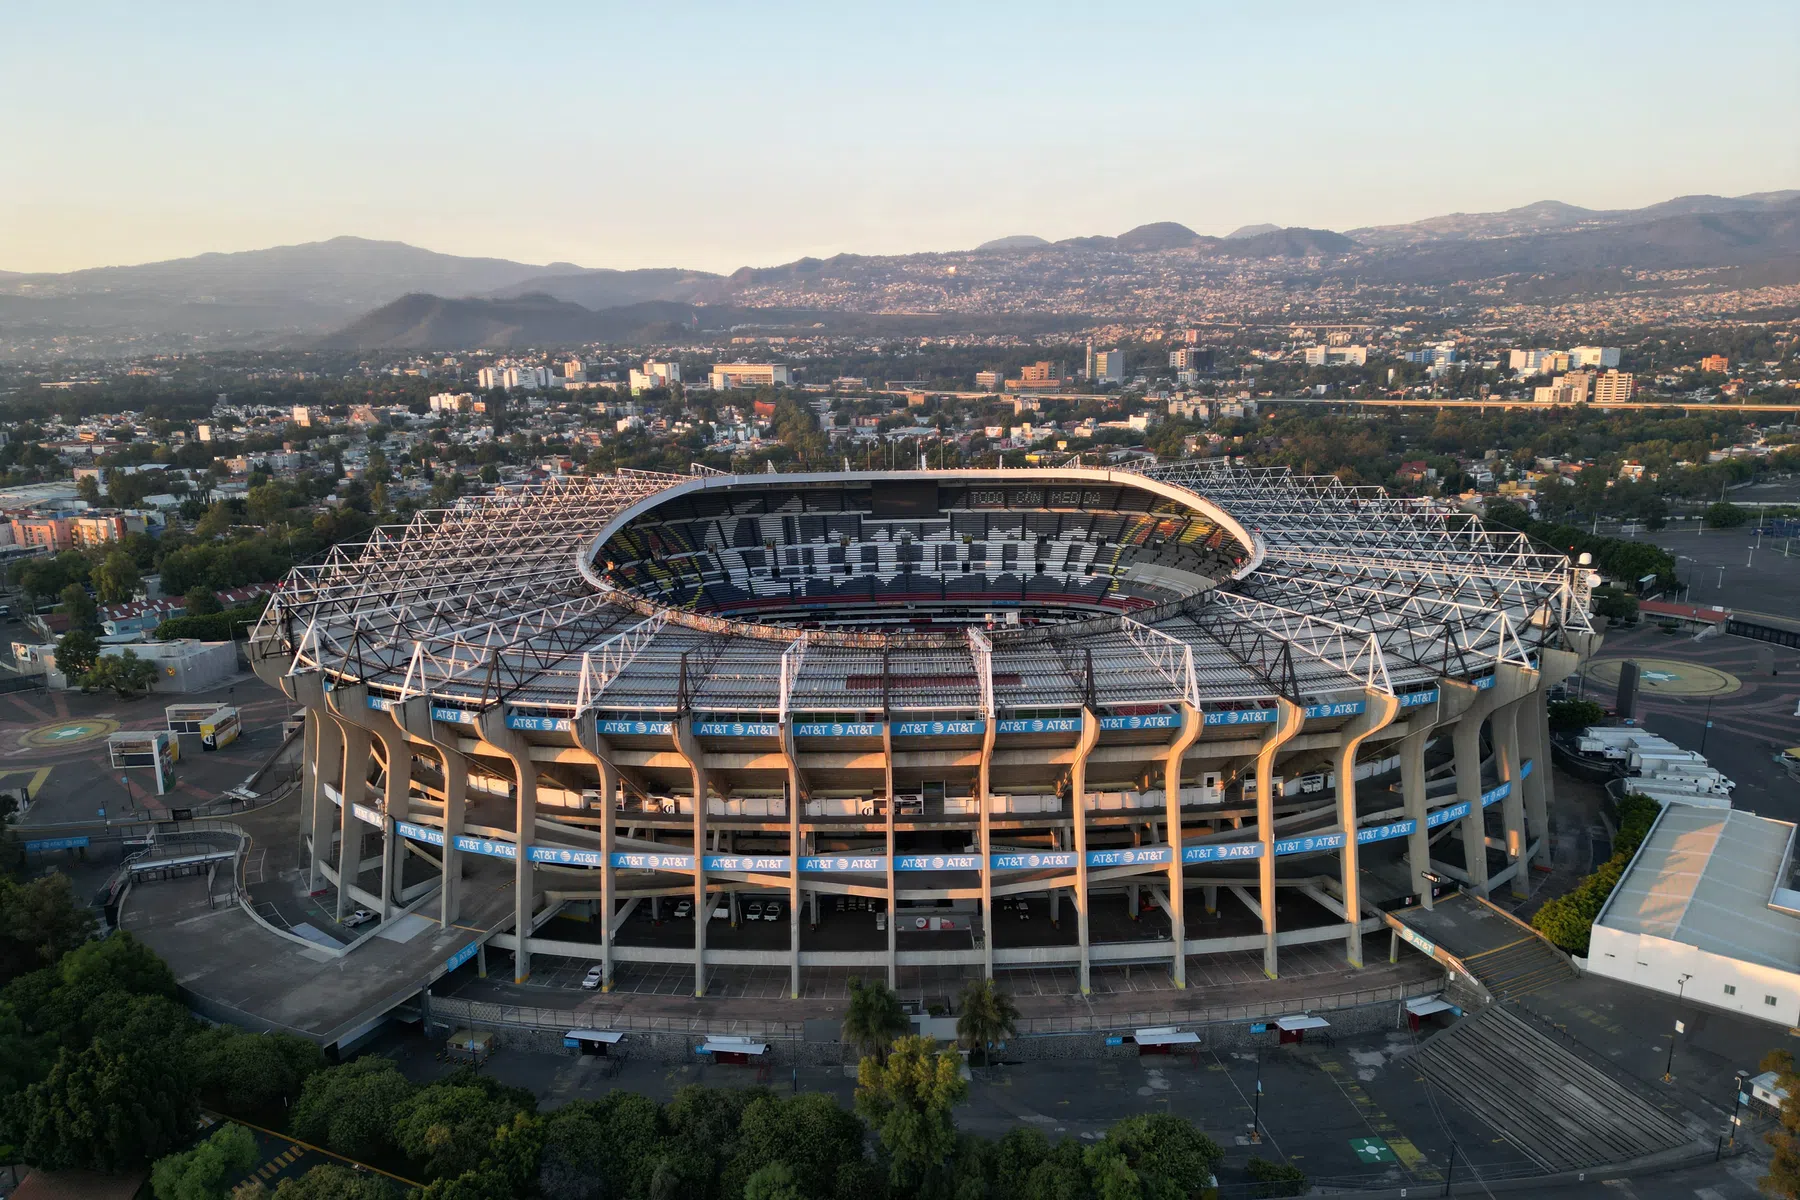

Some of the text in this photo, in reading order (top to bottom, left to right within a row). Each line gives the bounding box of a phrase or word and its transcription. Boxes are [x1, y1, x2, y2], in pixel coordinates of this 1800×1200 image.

[971, 491, 1004, 504] TODO
[1412, 692, 1434, 703] AT&T
[372, 700, 390, 710] AT&T
[1334, 703, 1359, 714] AT&T
[436, 709, 458, 721] AT&T
[1205, 711, 1269, 724] T&T AT&T
[513, 718, 538, 729] AT&T
[1000, 720, 1075, 732] AT&T AT&T
[1143, 716, 1172, 727] AT&T
[604, 722, 672, 734] AT&T AT&
[701, 724, 775, 735] AT&T AT&T
[800, 725, 875, 735] AT&T AT&T
[900, 722, 976, 734] AT&T AT&T
[1427, 804, 1468, 827] T&T AT&T
[400, 825, 417, 837] AT&T
[1357, 822, 1412, 841] AT&T AT&T
[458, 839, 517, 857] AT&T AT&T
[1276, 836, 1341, 853] AT&T AT&T
[532, 850, 598, 864] AT&T AT&T
[1092, 851, 1165, 864] AT&T AT&T
[1186, 845, 1257, 859] AT&T AT&T
[618, 856, 689, 867] AT&T AT&T
[711, 858, 784, 869] AT&T AT&T
[805, 859, 879, 869] AT&T AT&T
[901, 857, 975, 868] AT&T AT&T
[997, 855, 1071, 867] AT&T AT&T
[1413, 937, 1433, 952] AT&T
[459, 944, 475, 962] AT&T
